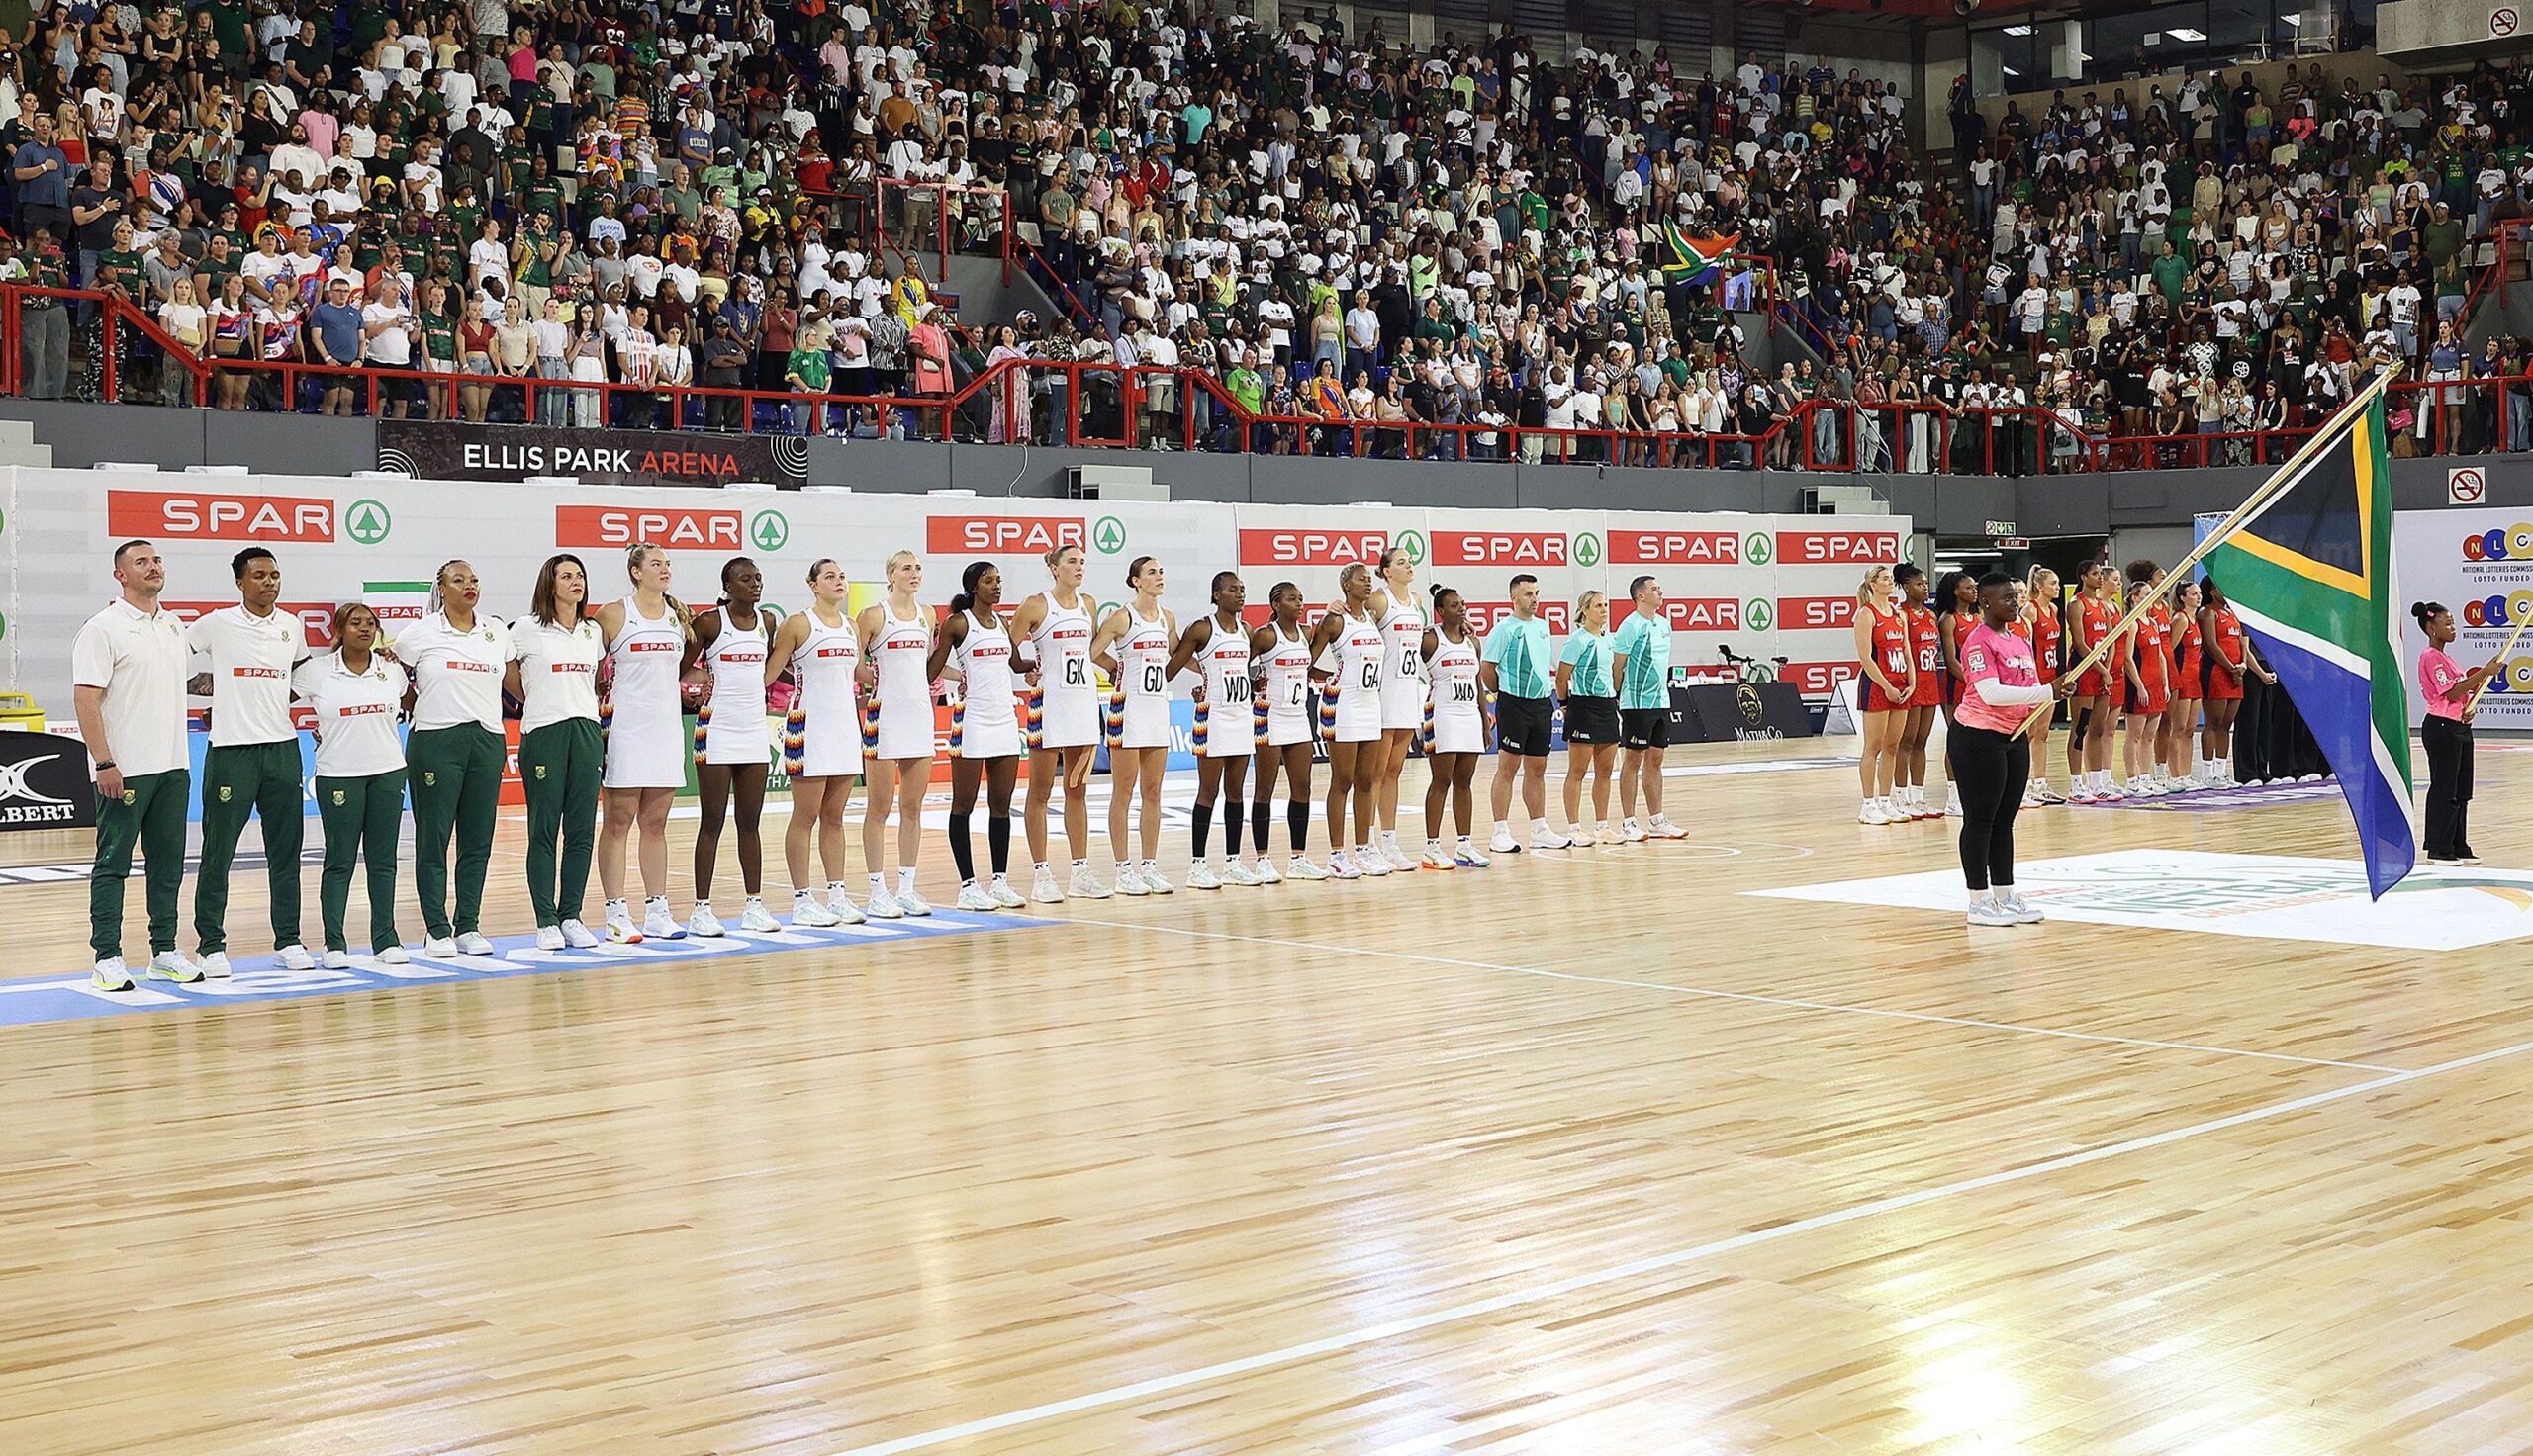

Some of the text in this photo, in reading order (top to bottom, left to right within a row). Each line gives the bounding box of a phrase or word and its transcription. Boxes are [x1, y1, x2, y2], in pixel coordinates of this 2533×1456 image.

[464, 443, 740, 476] ELLIS PARK ARENA
[162, 499, 331, 536] SPAR
[600, 513, 740, 544] SPAR
[964, 521, 1083, 549] SPAR
[1637, 535, 1736, 559] SPAR
[1272, 535, 1387, 560] SPAR
[1462, 535, 1566, 561] SPAR
[1804, 536, 1897, 559] SPAR
[379, 607, 422, 618] SPAR
[1466, 606, 1567, 634] SPR
[1666, 603, 1738, 627] PAR
[640, 643, 674, 652] SPAR
[828, 648, 856, 657] SPAR
[982, 647, 1009, 657] SPAR
[456, 662, 490, 672] SPAR
[560, 664, 591, 673] SPAR
[1066, 658, 1086, 685] GK
[1401, 649, 1418, 675] GS
[1920, 649, 1938, 671] GK
[244, 668, 279, 679] SPAR
[1144, 665, 1164, 692] GD
[1362, 662, 1381, 689] GA
[1224, 676, 1249, 703] WD
[1291, 682, 1302, 705] C
[350, 704, 386, 714] SPAR
[0, 803, 75, 824] BERT
